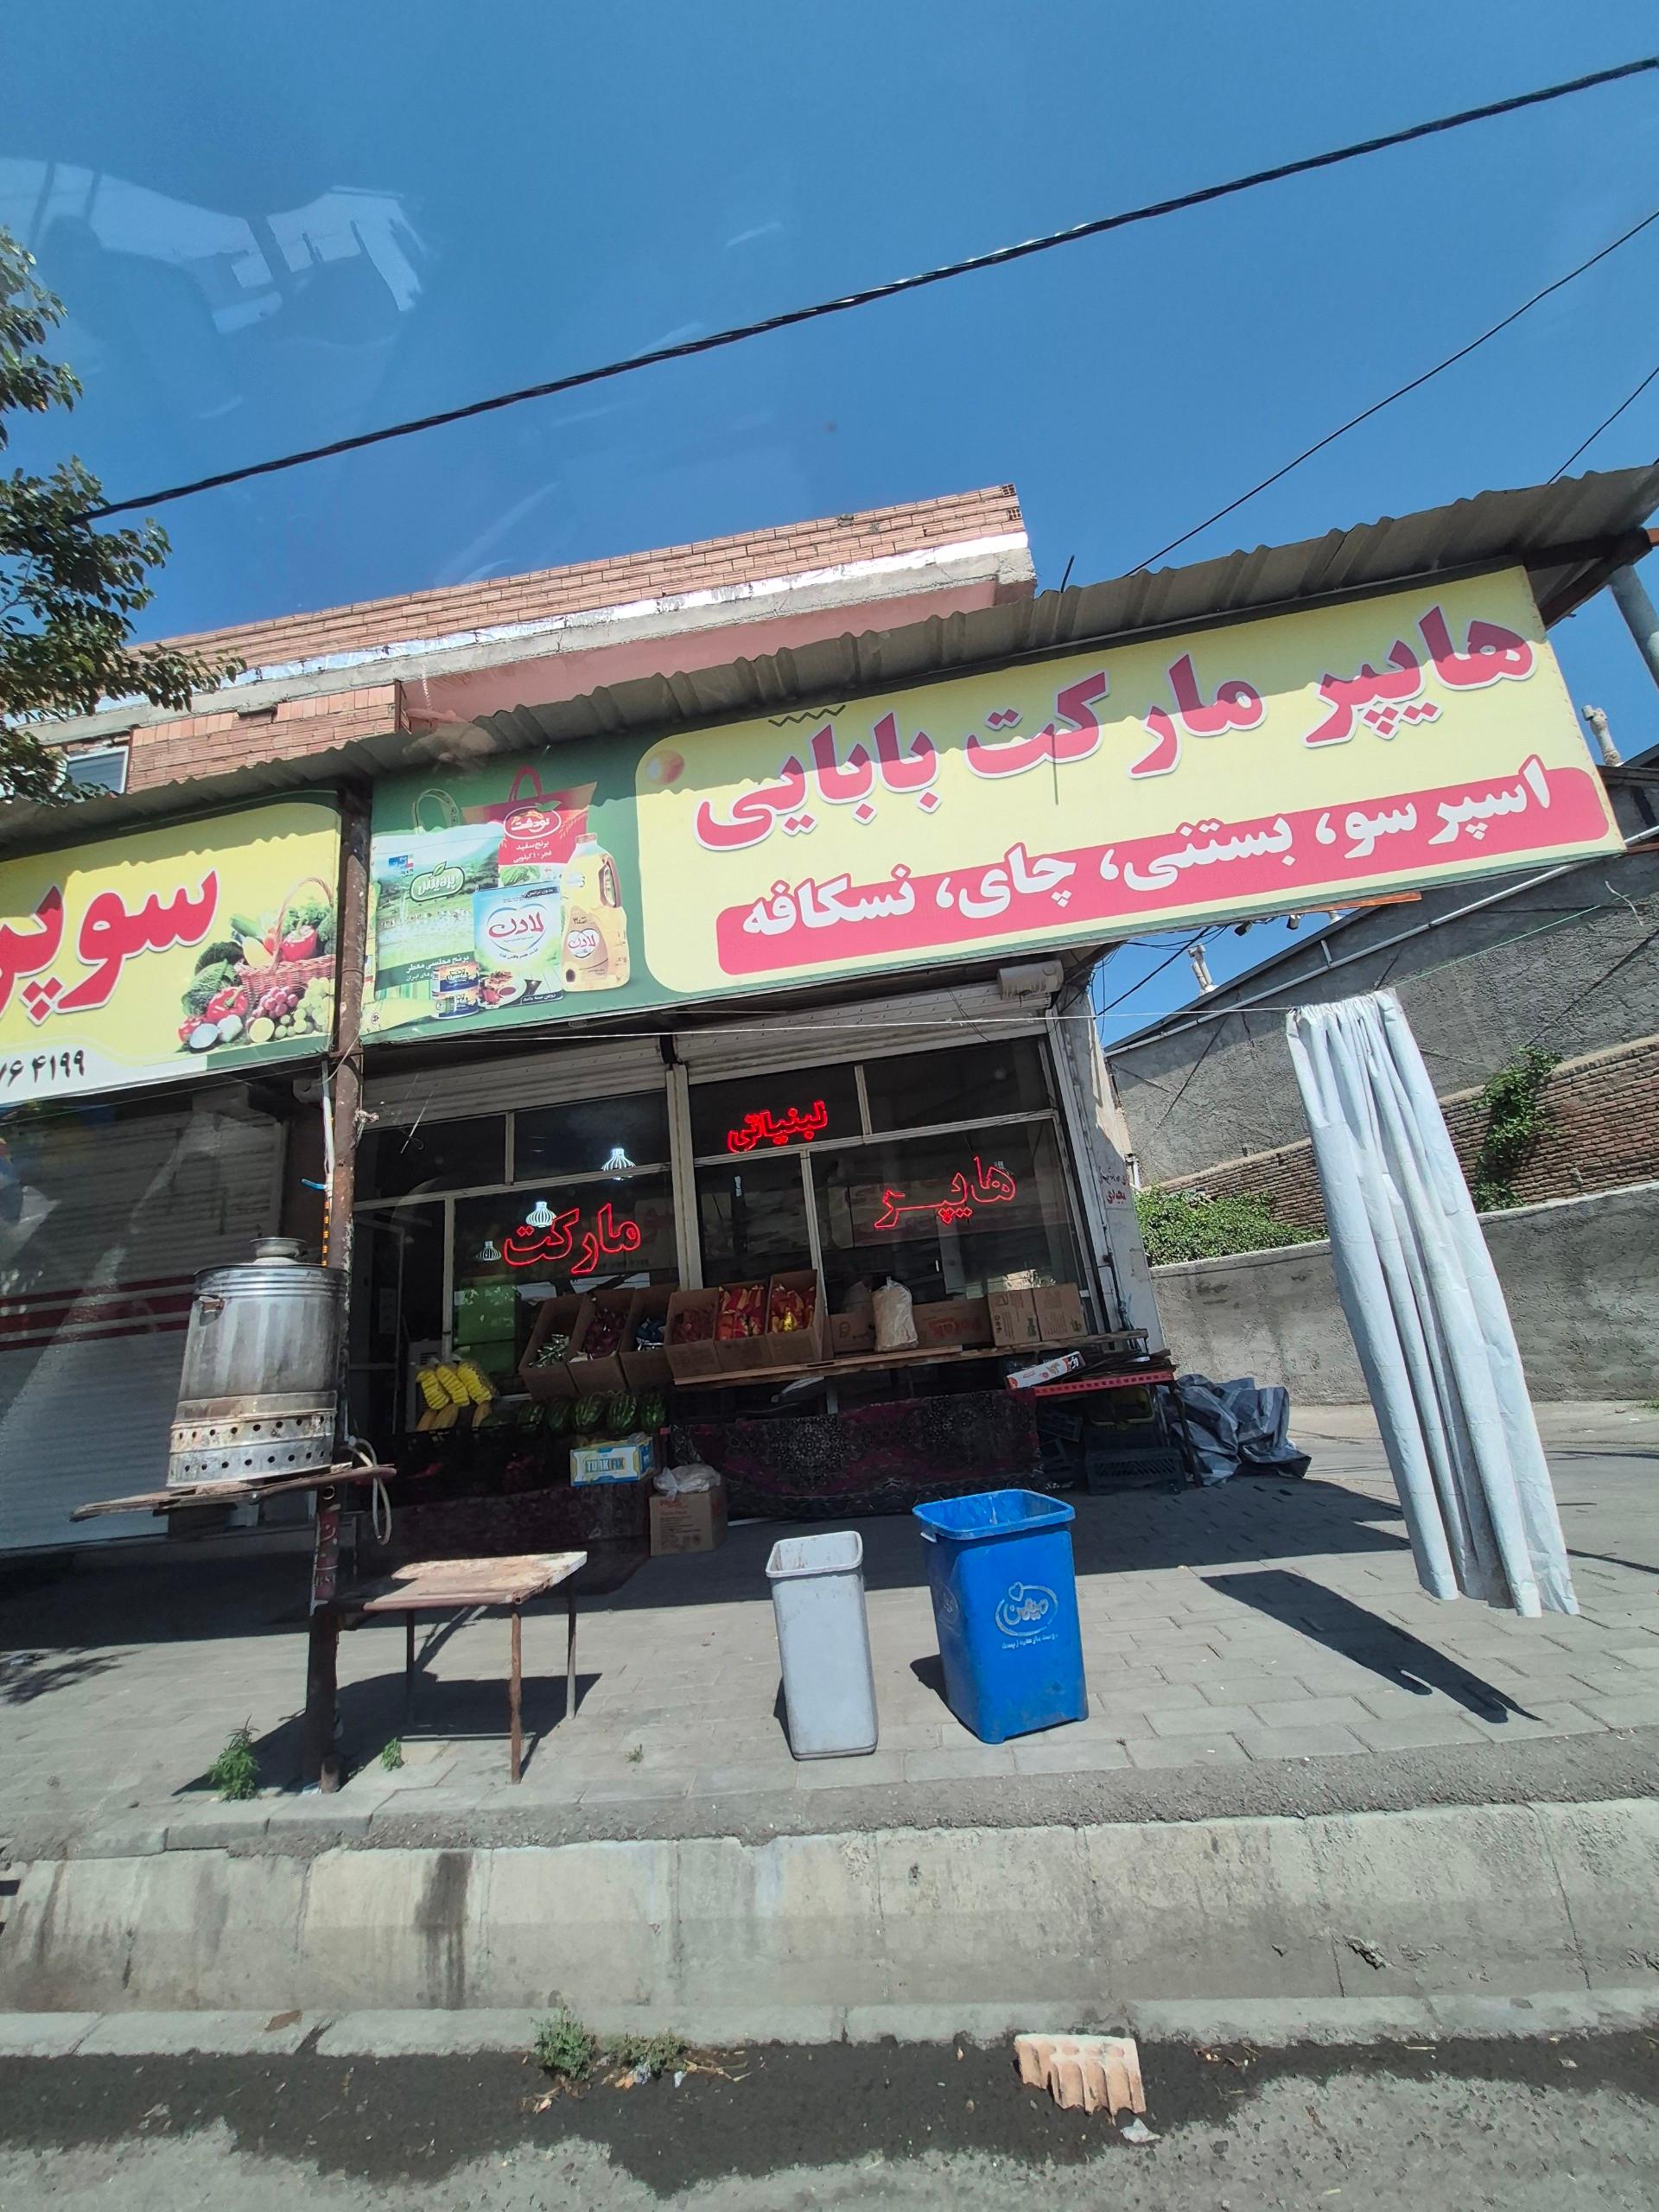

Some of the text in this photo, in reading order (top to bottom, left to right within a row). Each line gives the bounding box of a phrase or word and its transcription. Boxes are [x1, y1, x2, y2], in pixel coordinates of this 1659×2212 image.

[694, 605, 1538, 851] هایپر مارکت بابایی
[488, 912, 544, 938] لادن
[743, 867, 916, 936] نسکافه
[568, 934, 595, 949] لادن
[727, 1099, 828, 1154] لبنیاتی
[874, 1156, 1016, 1229] هایپر
[502, 1202, 642, 1275] مارکت
[1003, 1597, 1049, 1625] میهن
